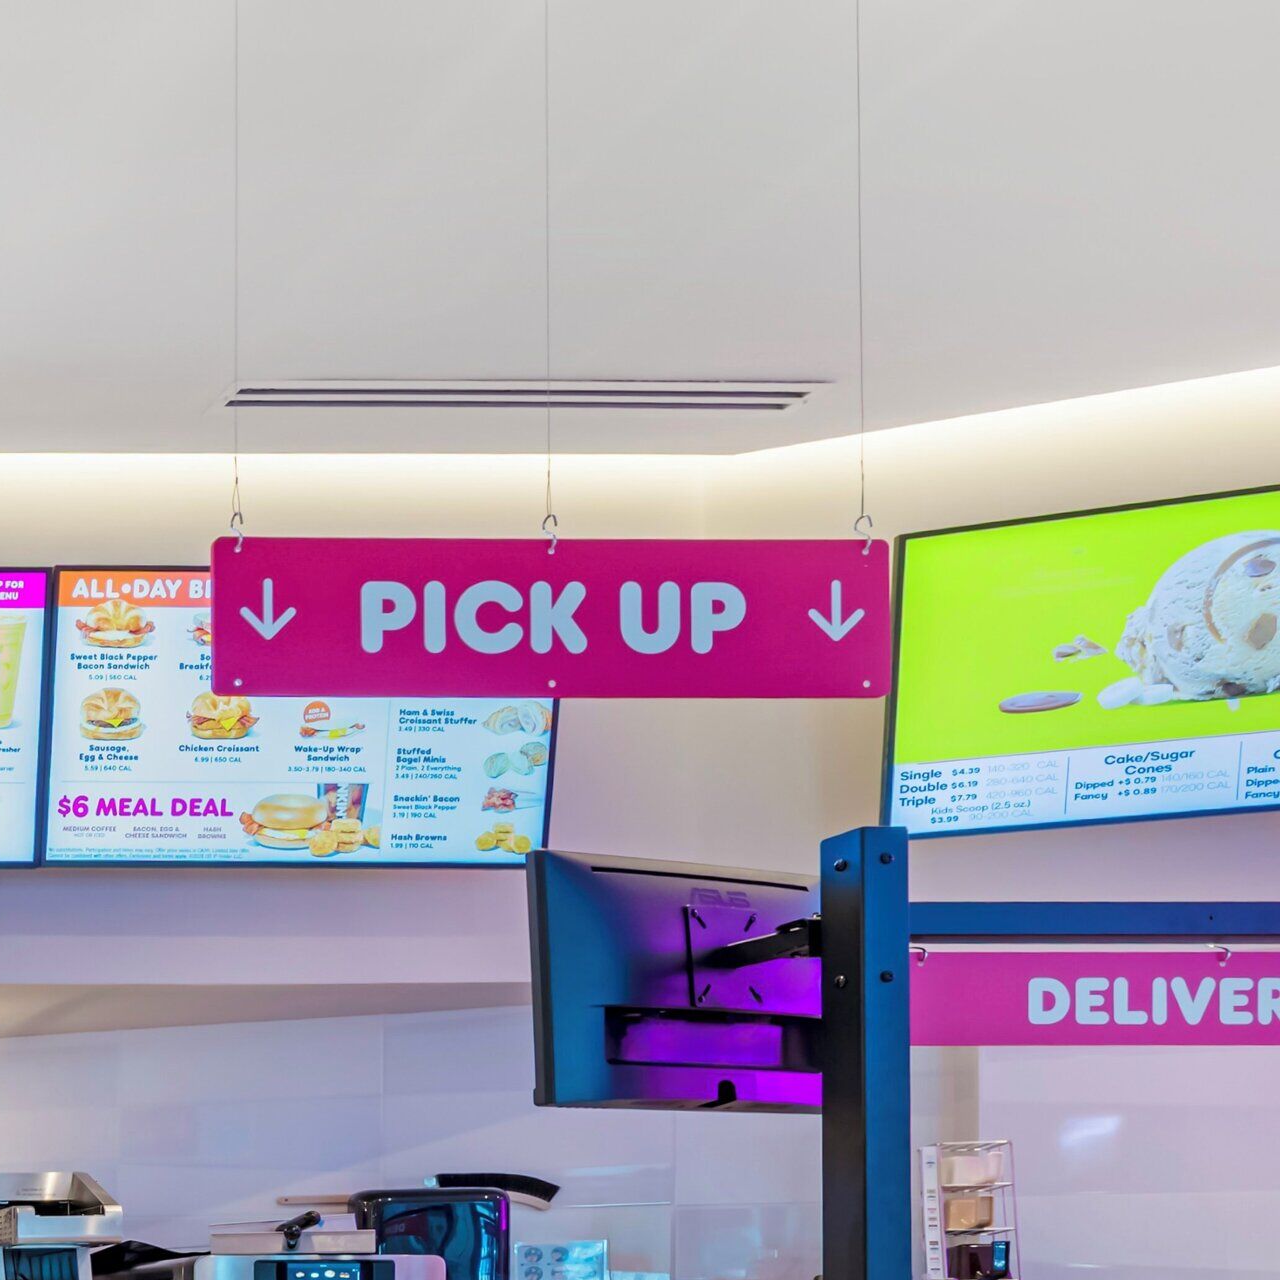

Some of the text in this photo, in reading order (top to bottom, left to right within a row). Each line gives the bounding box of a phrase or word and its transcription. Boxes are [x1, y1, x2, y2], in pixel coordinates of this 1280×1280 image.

[5, 580, 25, 589] FOR
[361, 580, 746, 655] PICK UP
[70, 653, 158, 663] Sweet Black Pepper
[77, 661, 150, 670] Bacon Sandwich
[179, 661, 212, 670] Breakf
[399, 708, 420, 717] Ham
[398, 716, 478, 725] Croissant Stuffer
[178, 744, 260, 753] Chicken Croissant
[396, 747, 432, 756] Stuffed
[79, 752, 139, 763] Egg & Cheese
[306, 754, 350, 762] Sandwich
[396, 755, 447, 765] Bagel Minis
[1104, 749, 1196, 765] Cake/Sugar
[1124, 764, 1173, 775] Cones
[1246, 765, 1276, 775] Plain
[900, 769, 942, 782] Single
[899, 781, 948, 794] Double
[1074, 779, 1115, 790] Dipped
[1245, 778, 1280, 788] Dippe
[433, 794, 460, 803] Bacon
[1074, 791, 1108, 801] Fancy
[58, 795, 233, 817] $6 MEAL DEAL
[899, 795, 937, 808] Triple
[955, 804, 989, 813] Scoop
[390, 833, 447, 841] Hash Browns
